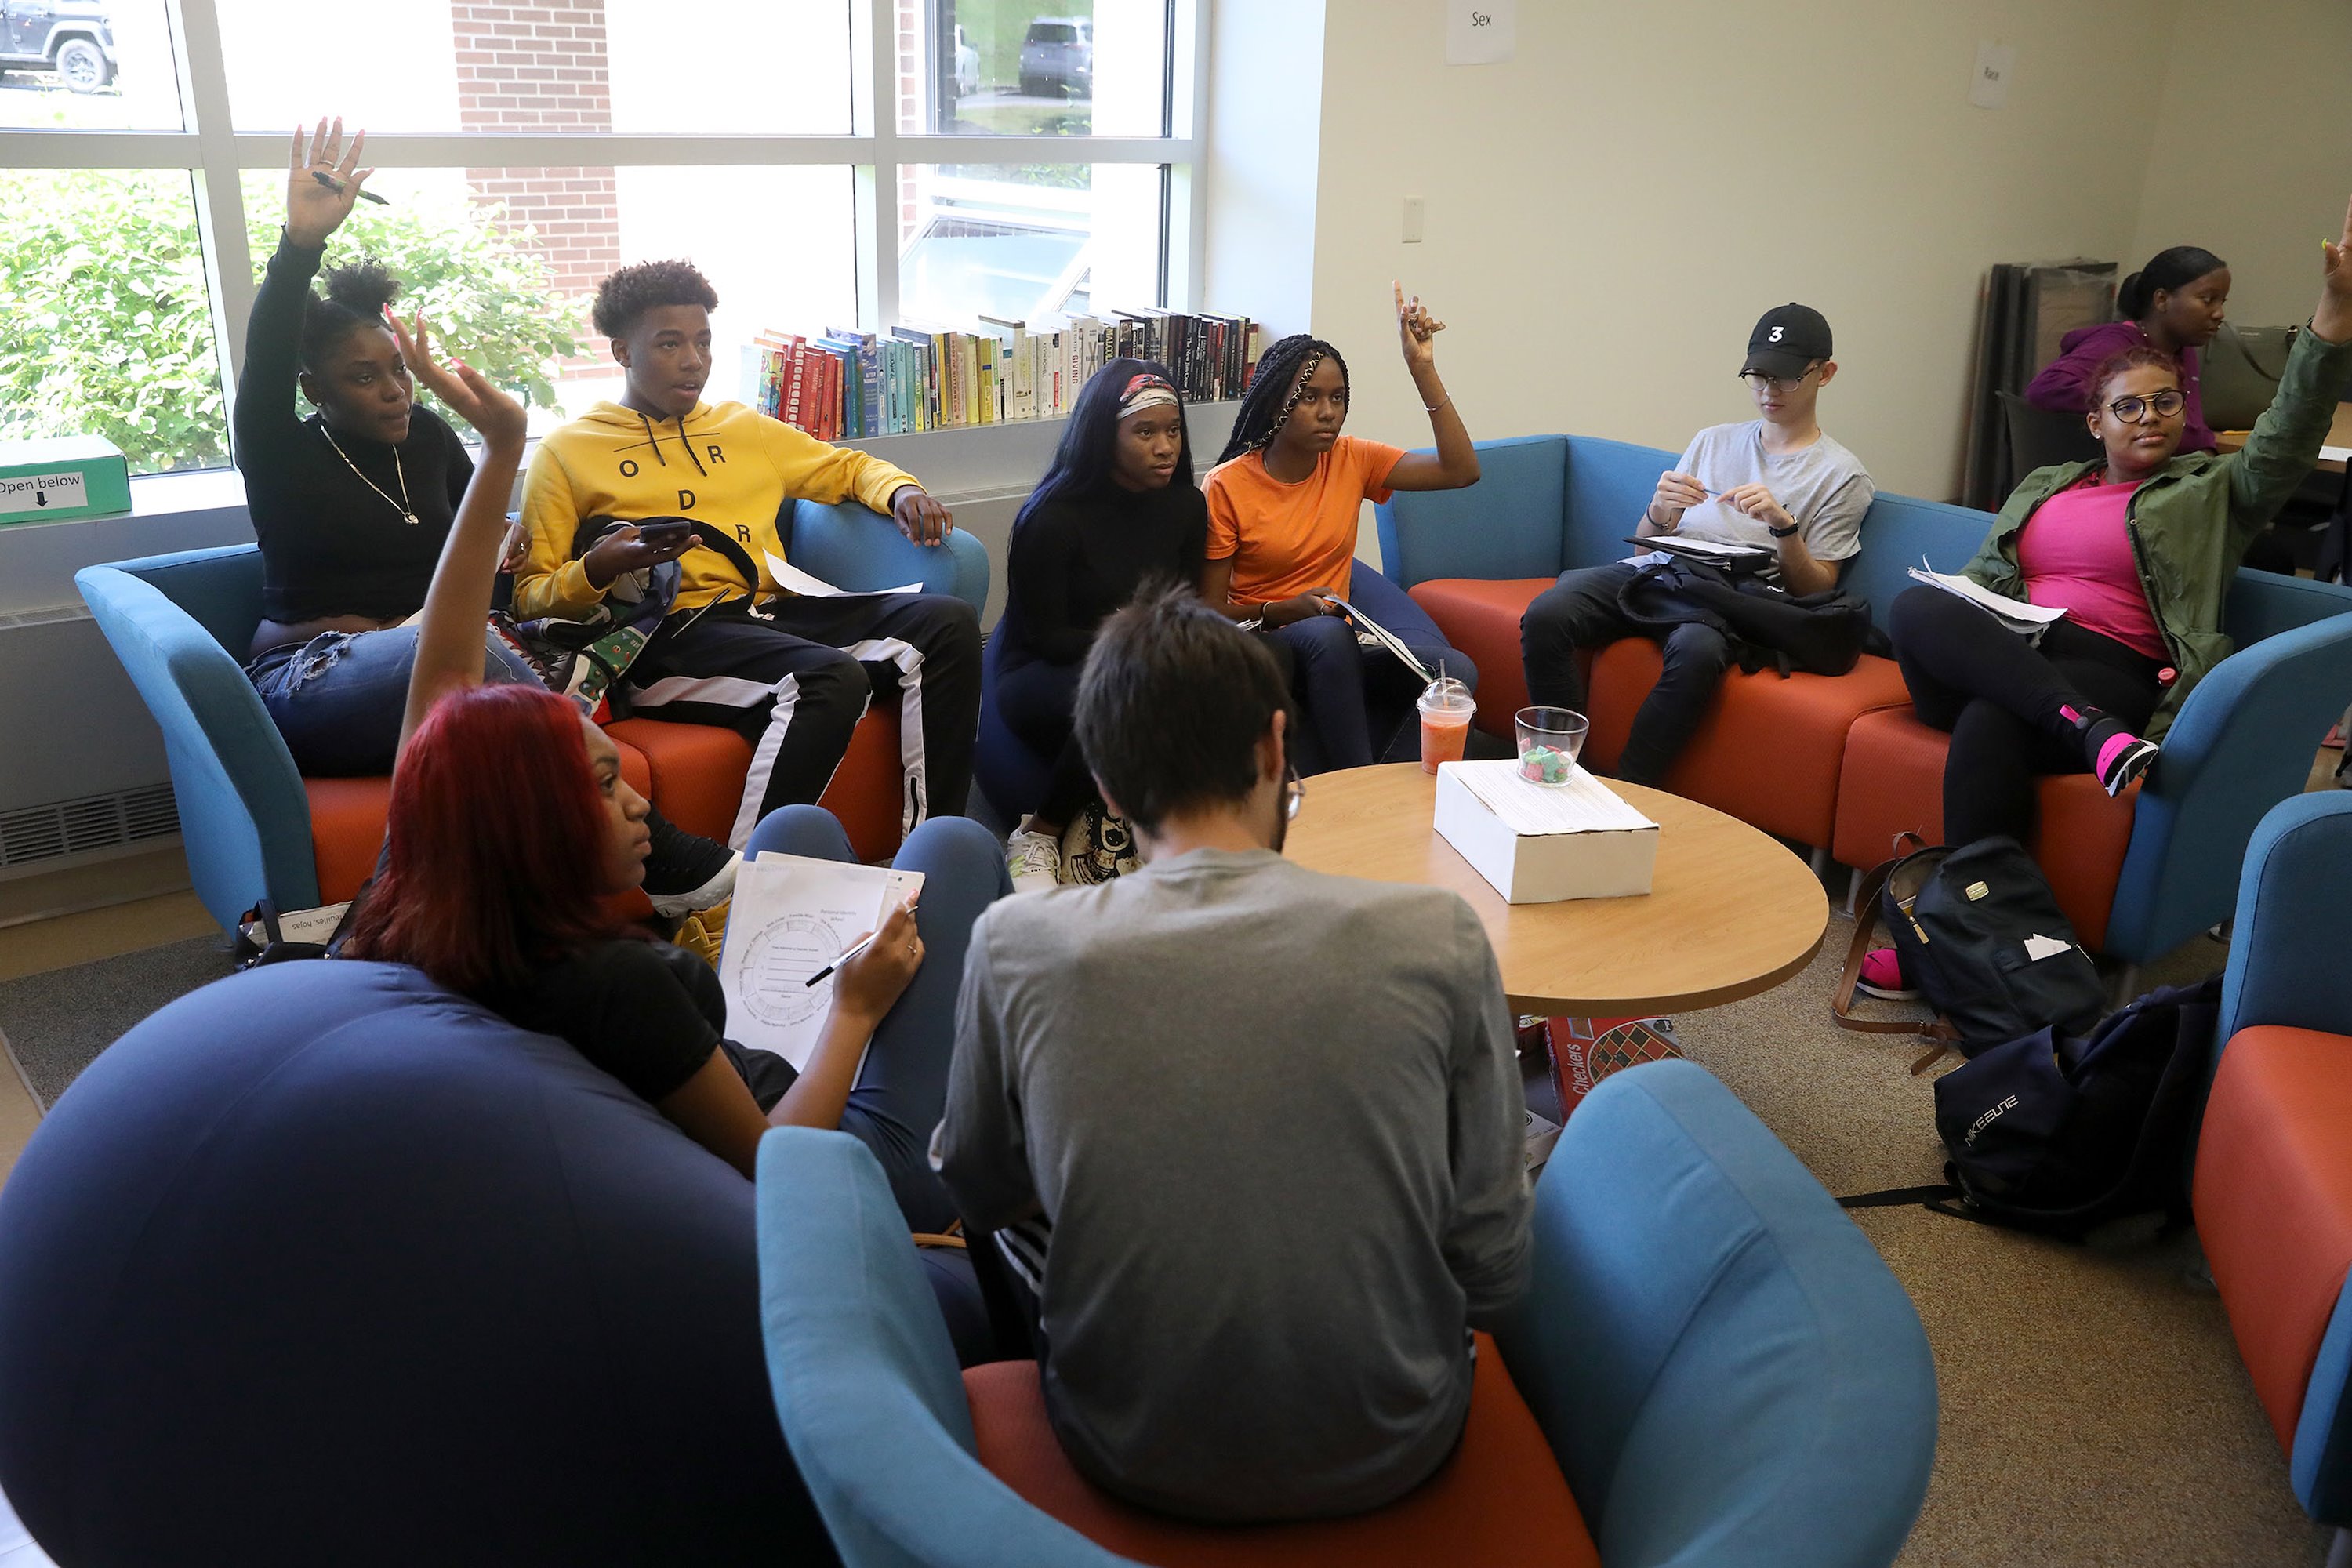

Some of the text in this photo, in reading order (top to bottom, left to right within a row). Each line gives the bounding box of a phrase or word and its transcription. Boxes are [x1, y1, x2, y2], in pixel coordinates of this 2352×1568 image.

[1472, 11, 1491, 27] Sex
[1768, 326, 1784, 343] 3
[1105, 327, 1114, 364] MALCOL
[953, 360, 956, 368] OF
[619, 445, 726, 477] O R
[0, 475, 80, 494] Open below
[678, 489, 696, 510] D
[735, 524, 751, 543] R
[292, 921, 312, 930] hojas
[1567, 1044, 1590, 1095] Checkers
